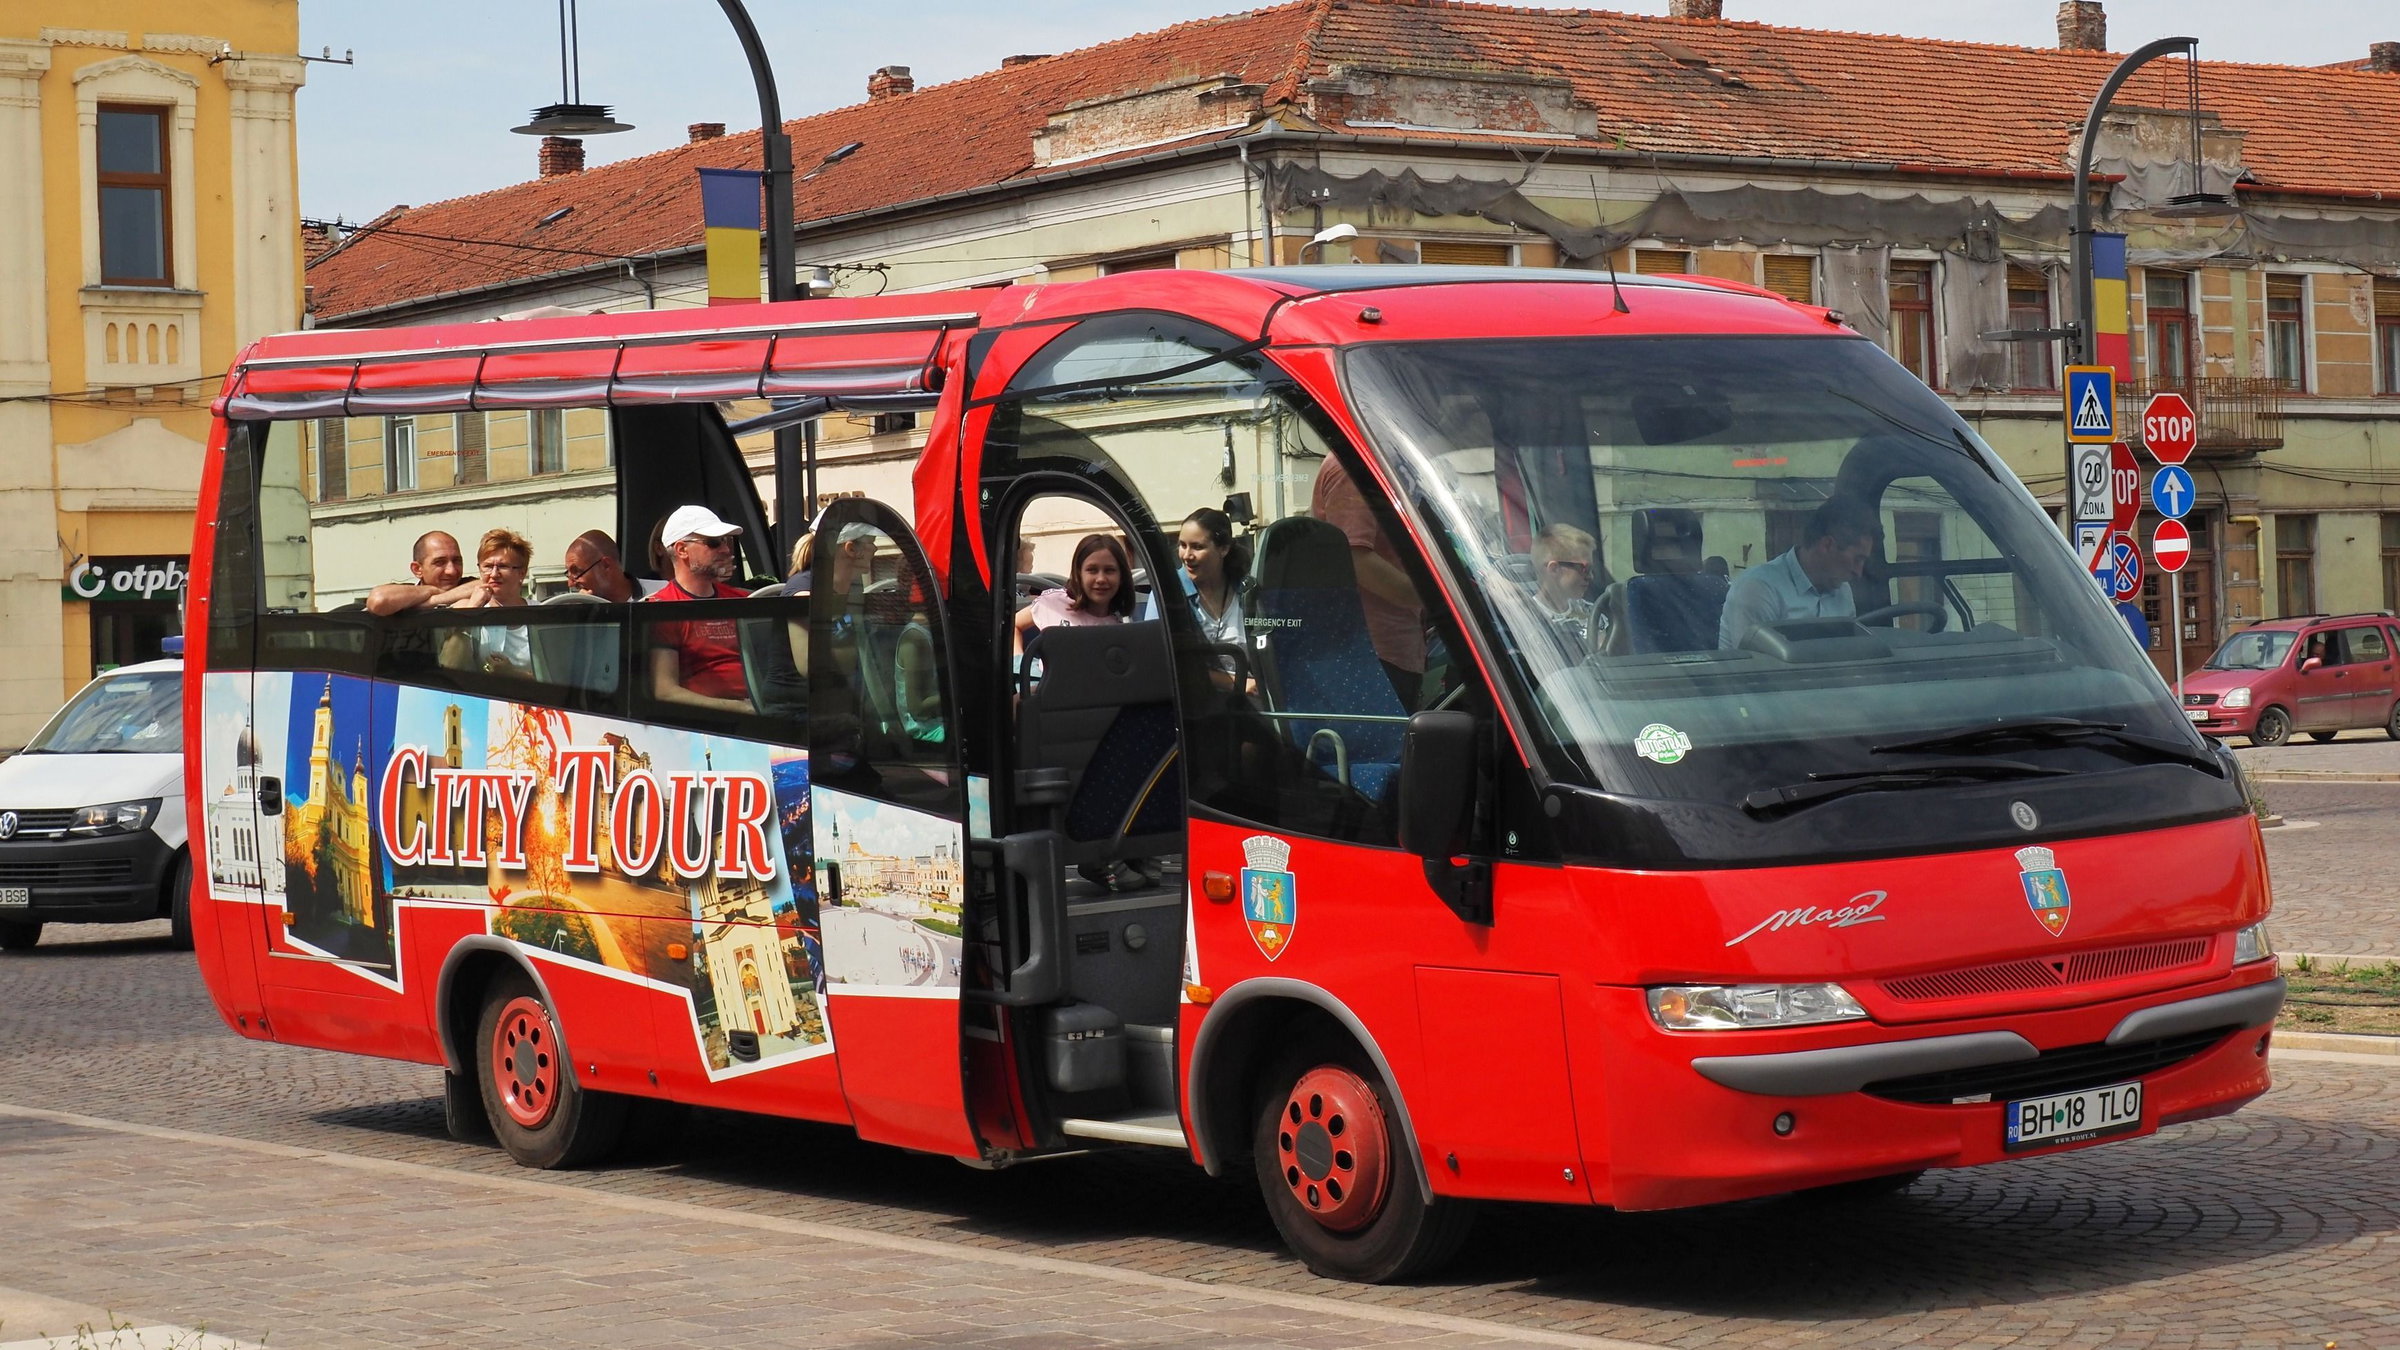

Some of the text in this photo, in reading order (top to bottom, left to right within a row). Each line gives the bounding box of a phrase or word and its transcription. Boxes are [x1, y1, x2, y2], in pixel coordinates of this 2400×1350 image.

[2147, 416, 2193, 442] STOP
[2085, 462, 2102, 484] 20
[2112, 468, 2138, 504] OP
[2084, 501, 2105, 515] ZONA
[2096, 577, 2108, 590] NA
[1244, 617, 1303, 627] EMERGENCY EXIT
[379, 743, 777, 882] CITY TOUR
[6, 890, 27, 903] BSB
[2021, 1086, 2138, 1136] BH 18 TLO
[2008, 1125, 2019, 1139] RO
